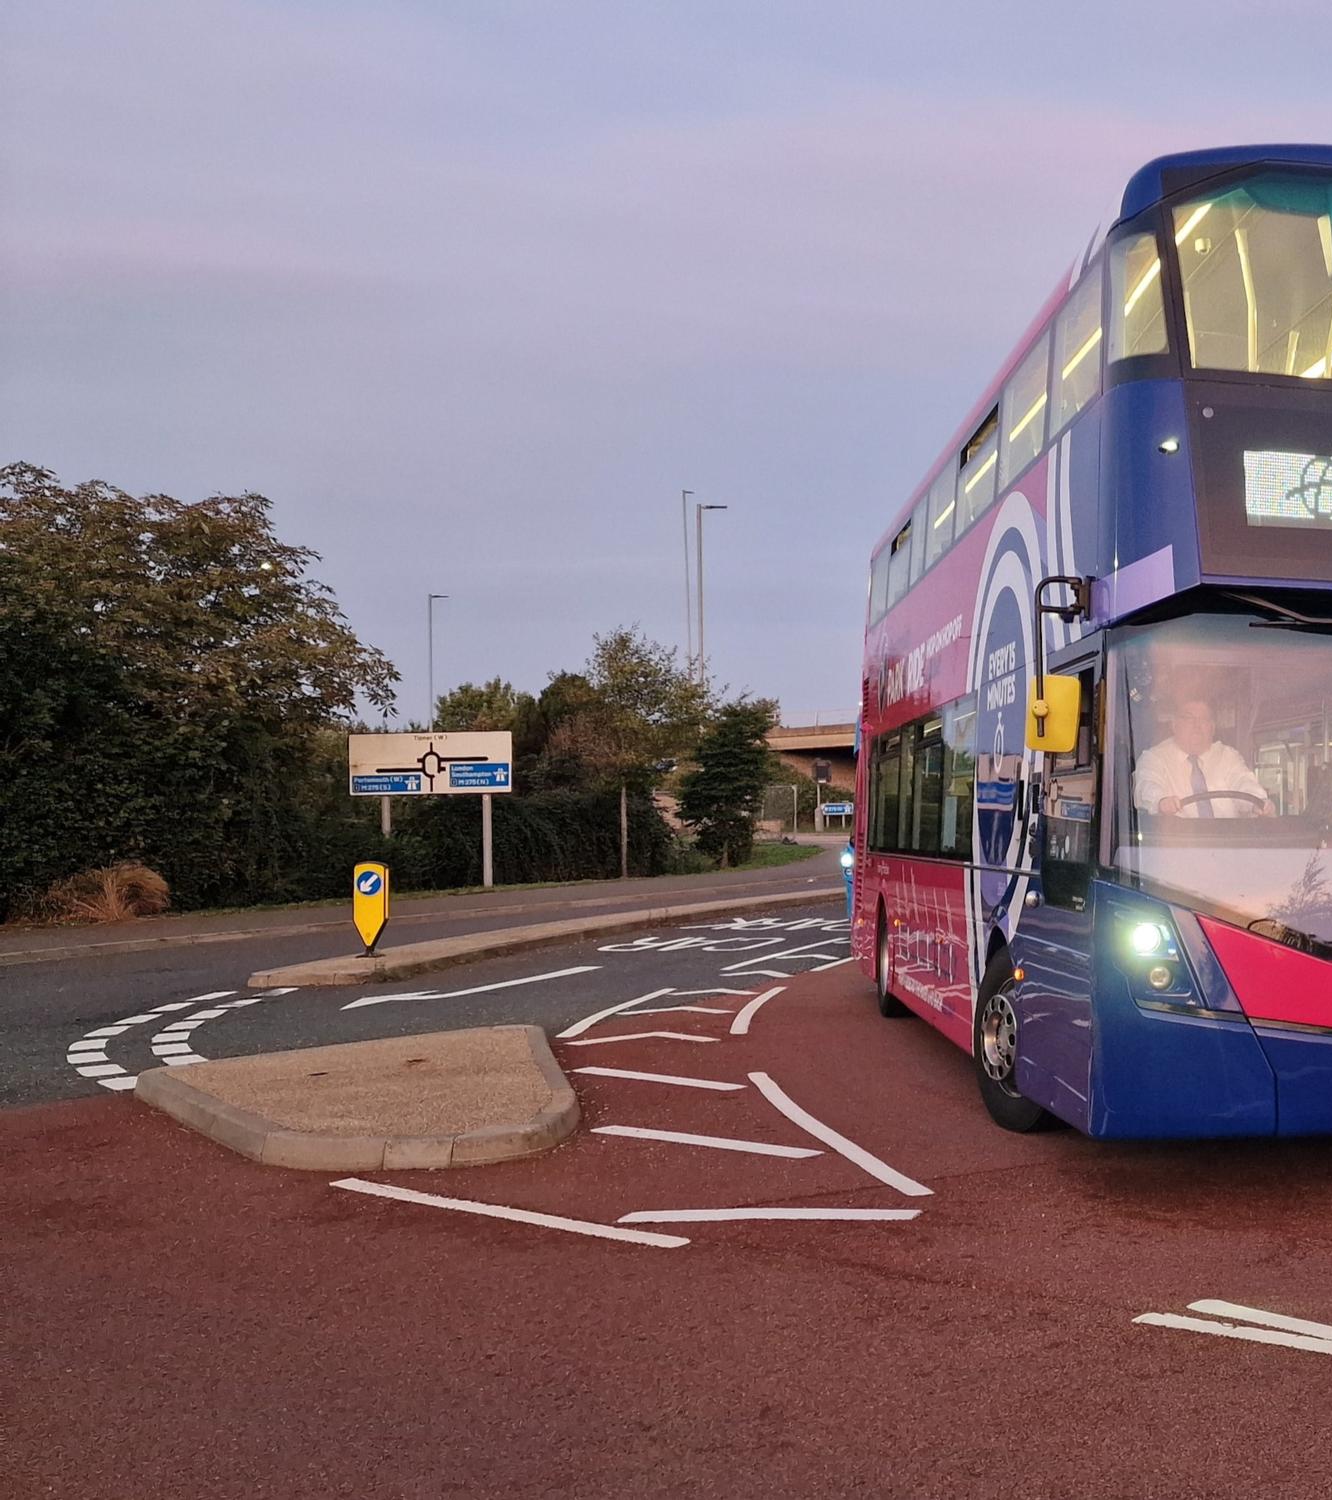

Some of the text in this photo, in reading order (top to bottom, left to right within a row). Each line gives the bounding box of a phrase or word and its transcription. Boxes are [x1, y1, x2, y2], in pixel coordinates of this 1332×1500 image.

[988, 644, 1009, 681] EVERY
[987, 674, 1016, 711] MINUTES
[597, 936, 787, 952] CAR
